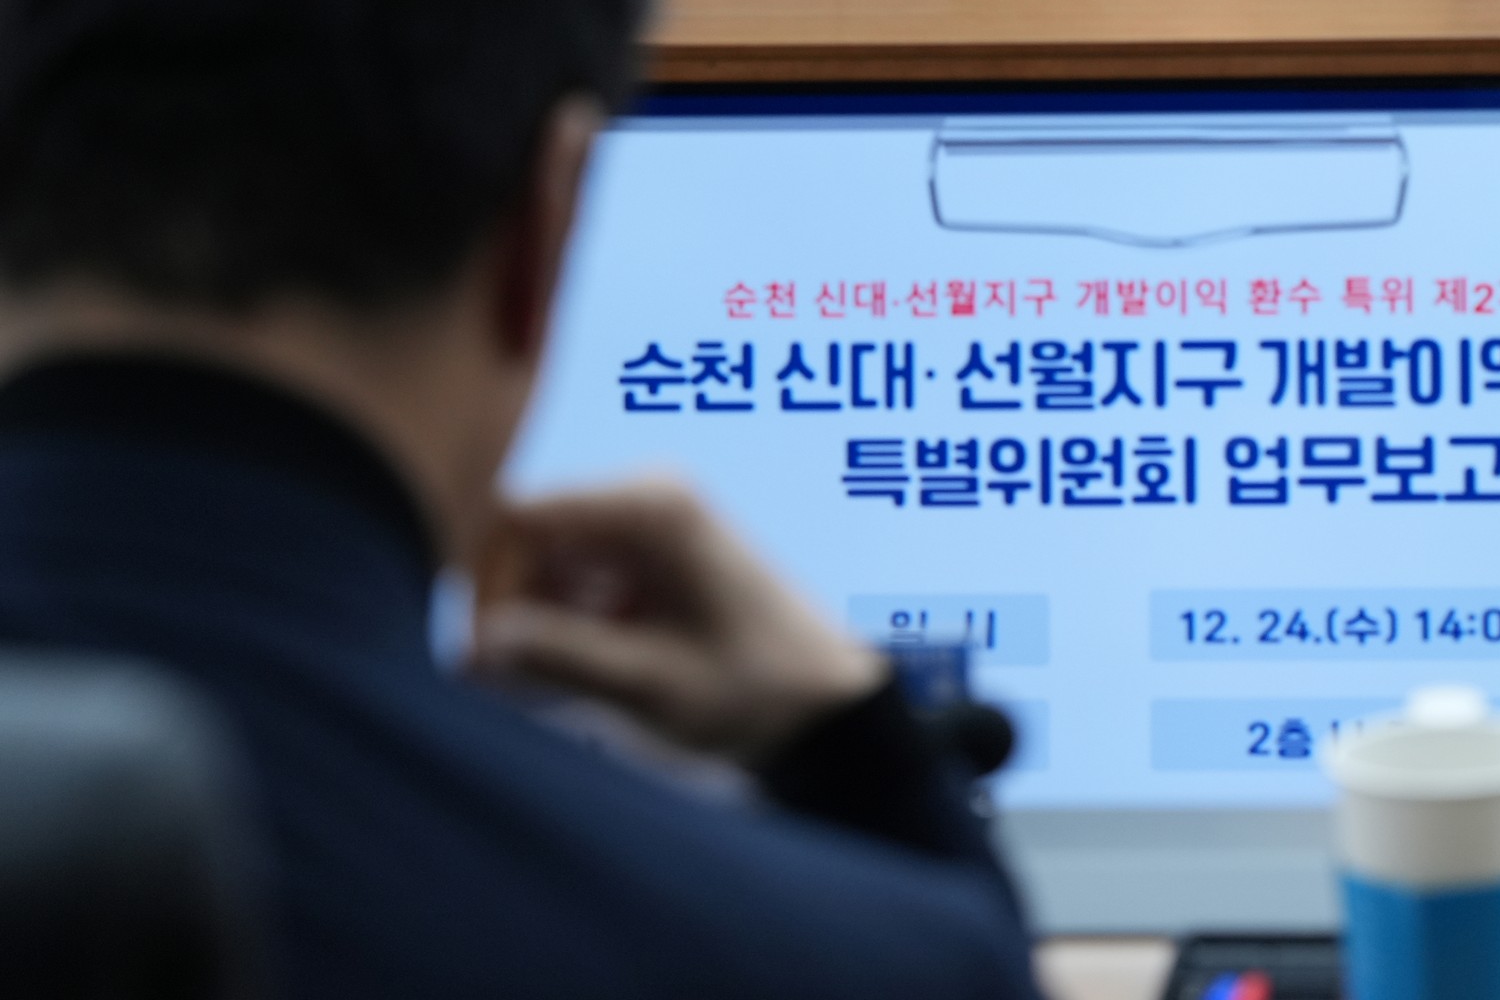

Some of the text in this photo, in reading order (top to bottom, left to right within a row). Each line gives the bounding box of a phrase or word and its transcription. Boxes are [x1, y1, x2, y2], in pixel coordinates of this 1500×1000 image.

[723, 280, 798, 320] 순천
[1076, 278, 1229, 318] 개발이익
[1248, 277, 1323, 316] 환수
[1341, 275, 1416, 315] 특위
[617, 340, 756, 413] 순천
[954, 339, 1244, 411] 선월지구
[840, 435, 1199, 508] 특별위원회
[1180, 609, 1241, 645] 12.
[1257, 606, 1400, 646] 24.(수)
[1247, 718, 1314, 760] 2층
